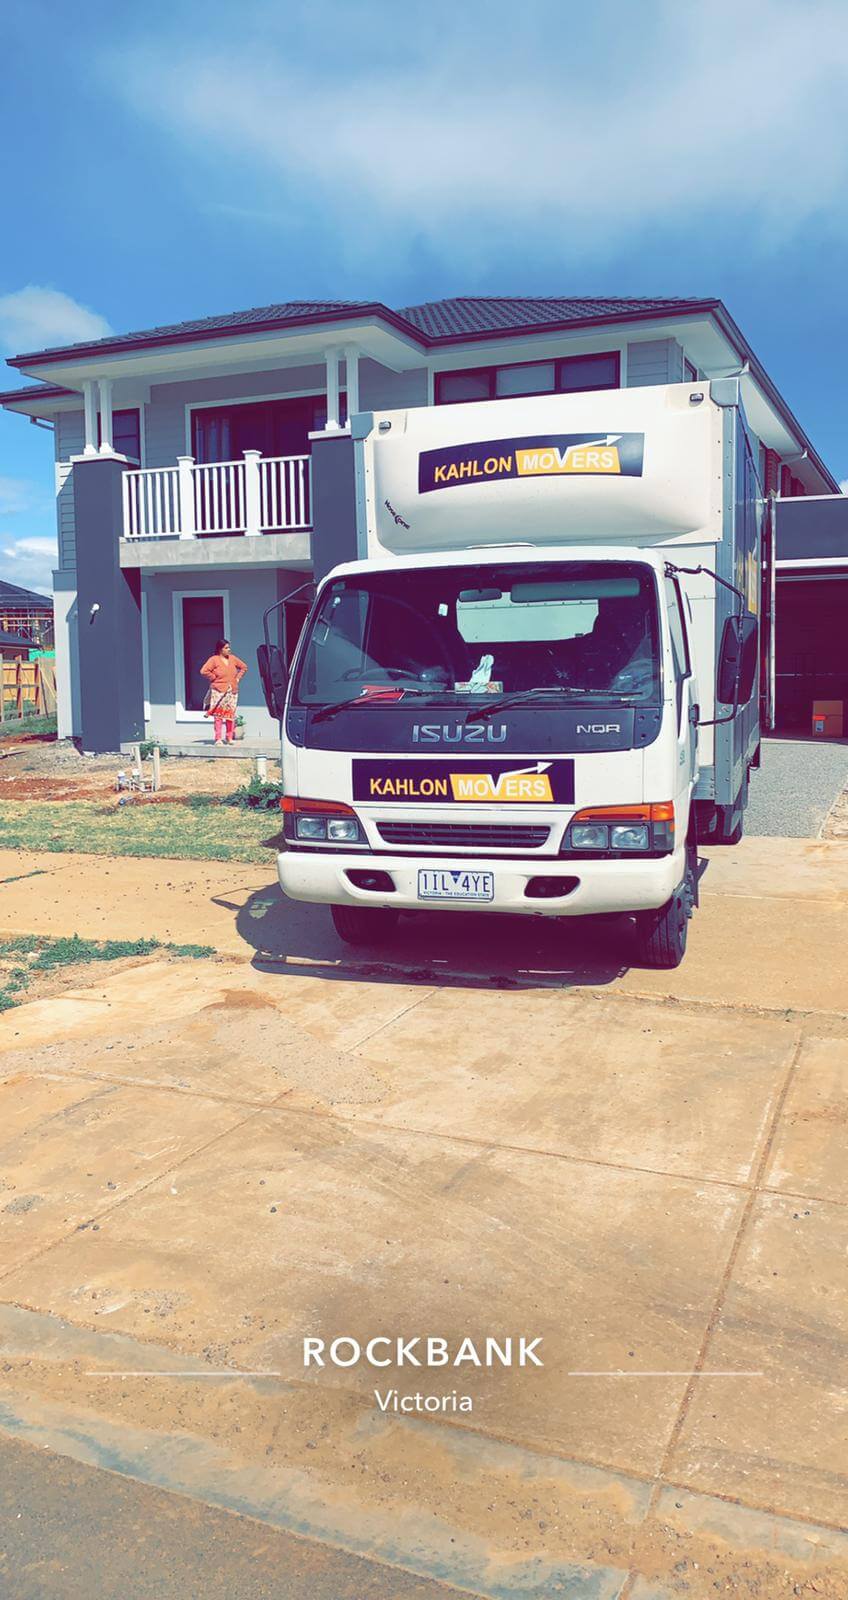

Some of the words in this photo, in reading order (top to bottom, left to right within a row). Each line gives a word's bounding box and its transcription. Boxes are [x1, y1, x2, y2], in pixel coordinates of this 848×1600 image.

[433, 456, 513, 483] KAHLON
[522, 447, 614, 472] MOVERS
[412, 724, 507, 743] ISUZU
[576, 724, 621, 734] NQR
[369, 778, 448, 796] KAHLON
[458, 774, 546, 797] MOVERS
